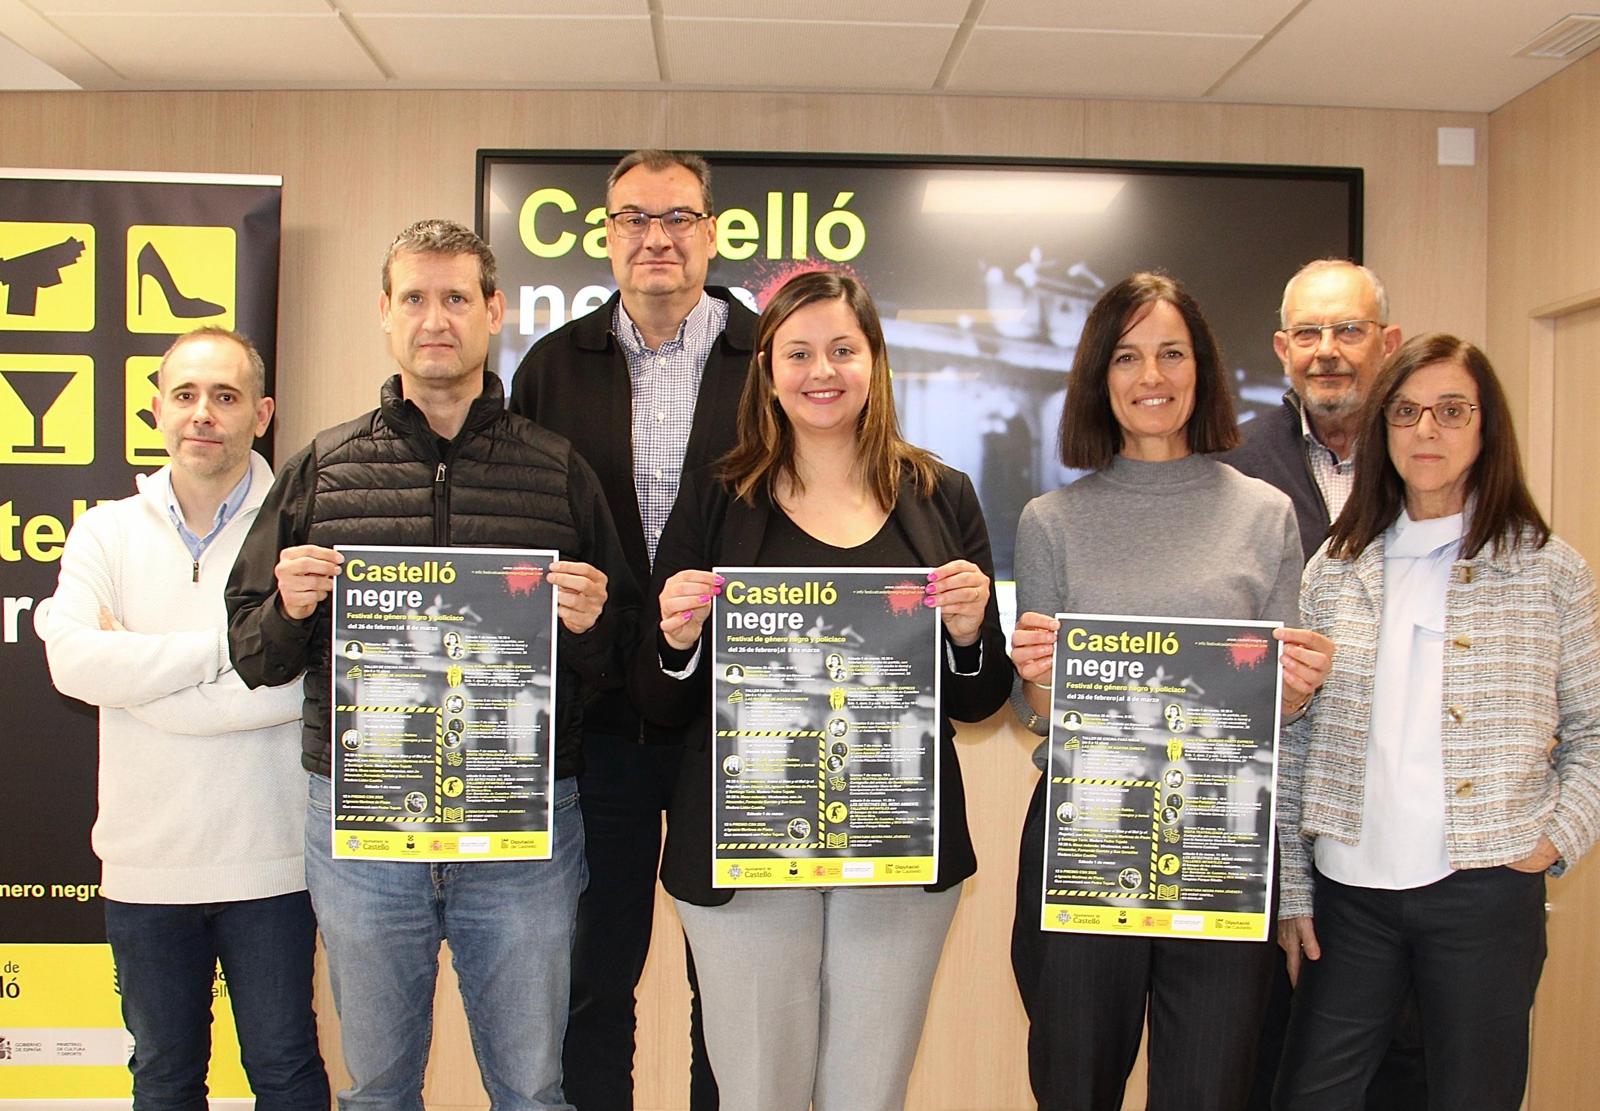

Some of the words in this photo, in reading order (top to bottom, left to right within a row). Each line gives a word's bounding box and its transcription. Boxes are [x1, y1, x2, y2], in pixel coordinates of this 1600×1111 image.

[518, 187, 867, 262] Caelló
[346, 558, 456, 584] Castelló
[346, 589, 423, 612] negre
[726, 581, 837, 605] Castelló
[726, 612, 804, 636] negre
[1067, 628, 1179, 655] Castelló
[1066, 658, 1144, 683] negre
[4, 960, 20, 973] de
